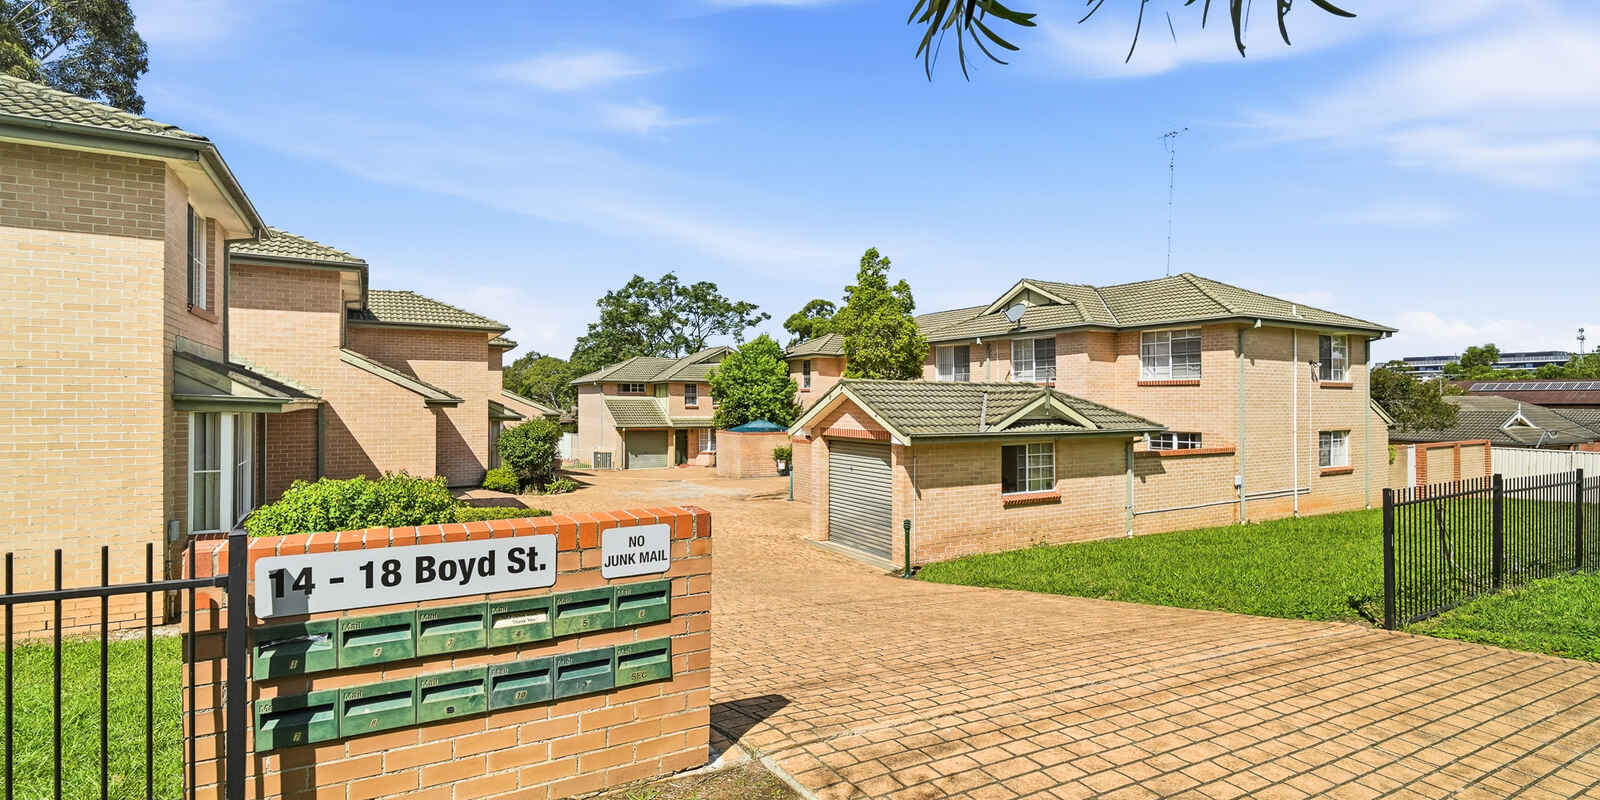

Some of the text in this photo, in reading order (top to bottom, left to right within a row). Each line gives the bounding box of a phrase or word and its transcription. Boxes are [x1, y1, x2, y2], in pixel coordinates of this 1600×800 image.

[628, 534, 646, 548] NO
[604, 548, 668, 568] JUNK MAIL
[268, 545, 547, 599] 14 - 18 Boyd St.
[631, 671, 648, 681] SEC
